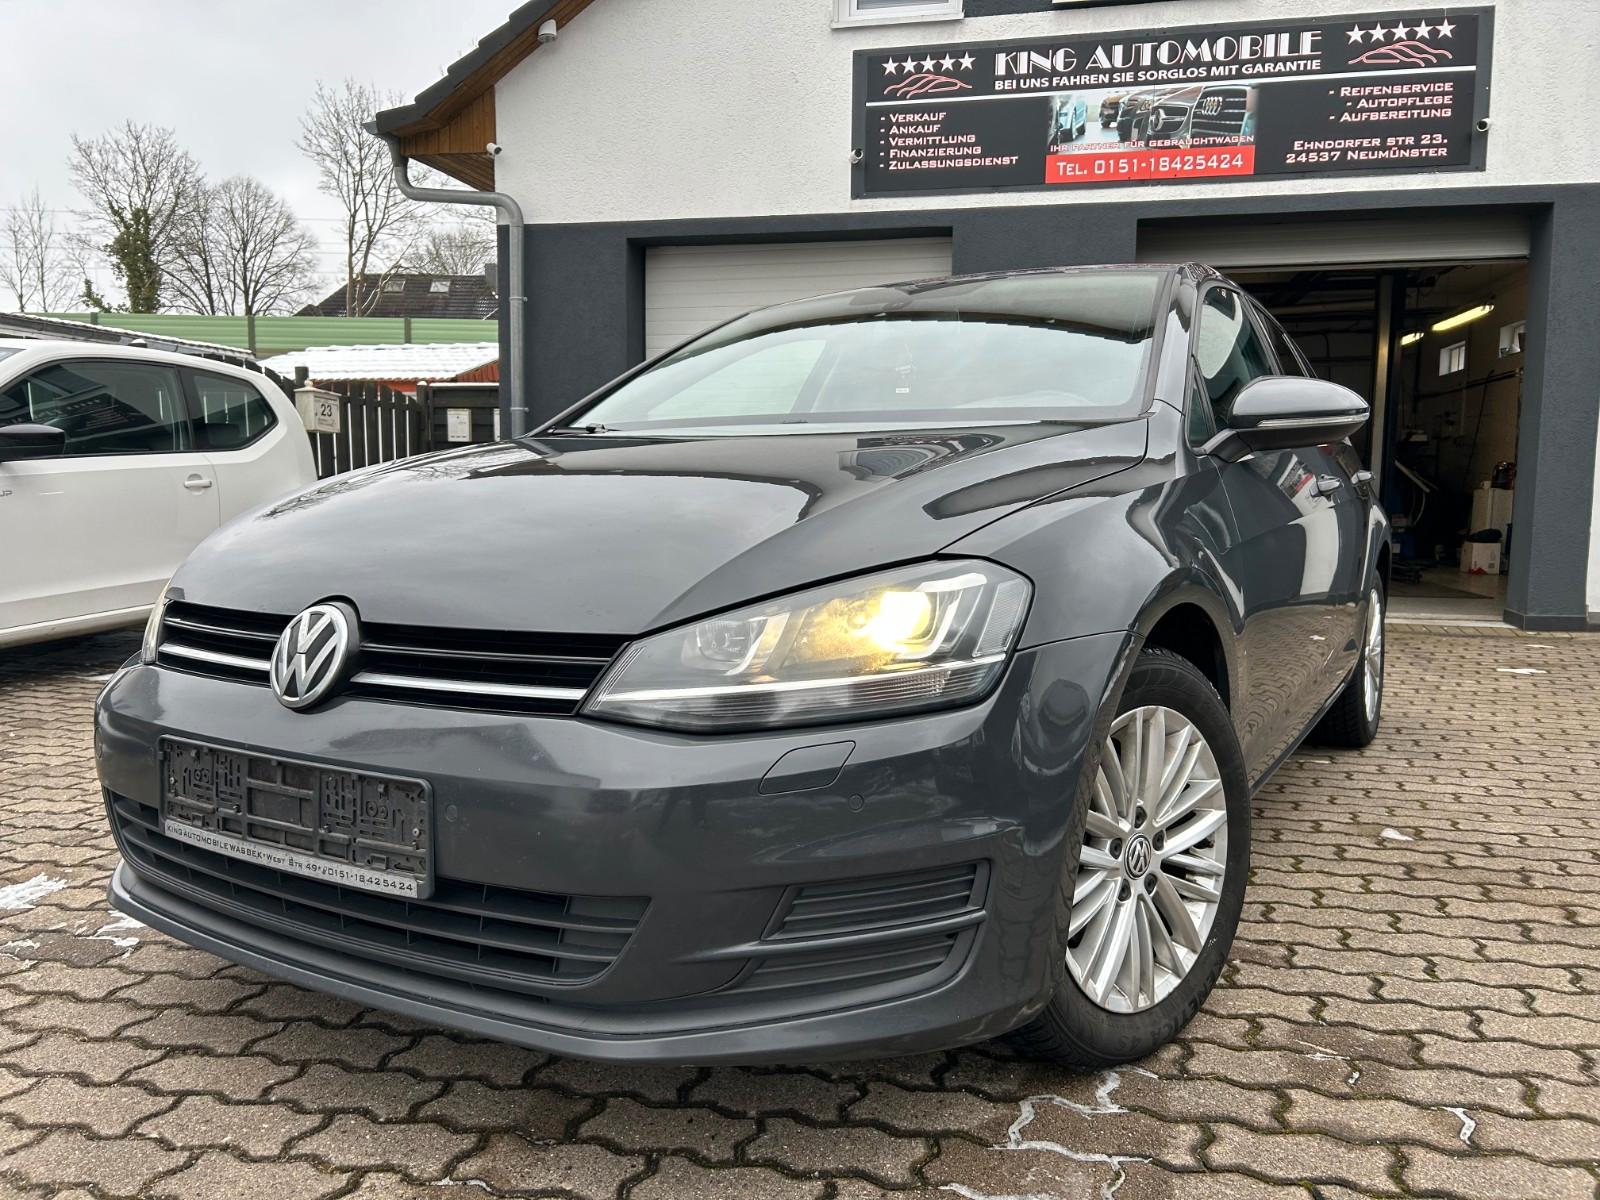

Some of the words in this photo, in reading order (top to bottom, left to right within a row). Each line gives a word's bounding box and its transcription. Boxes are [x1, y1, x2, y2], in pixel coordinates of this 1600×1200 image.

[994, 47, 1077, 76] KING
[1085, 30, 1323, 70] AUTOMOBILE
[994, 79, 1017, 91] BEI
[1020, 77, 1049, 88] UNS
[1052, 73, 1109, 87] FAHREN
[1112, 71, 1134, 83] SIE
[1137, 67, 1207, 81] SORGLOS
[1210, 65, 1239, 77] MIT
[1241, 59, 1321, 74] GARANTIE
[1340, 82, 1454, 97] REIFENSERVICE
[1356, 95, 1453, 109] AUTOPFLEGE
[889, 112, 947, 123] VERKAUF
[1339, 108, 1452, 123] AUFBEREITUNG
[889, 124, 941, 135] ANKAUF
[888, 134, 976, 146] VERMITTLUNG
[1050, 144, 1068, 152] IHR
[1072, 142, 1120, 151] PARTNER
[1124, 139, 1145, 148] FÜR
[1149, 135, 1255, 147] GEBRAUCHTWAGEN
[1293, 137, 1381, 151] EHNDORFER
[1386, 136, 1415, 146] STR
[1420, 133, 1448, 145] 23.
[889, 146, 982, 158] FINANZIERUNG
[1285, 150, 1341, 164] 24537
[1347, 147, 1448, 161] NEUMÜNSTER
[888, 156, 1019, 170] ZULASSUNGSDIENST
[1056, 161, 1088, 176] TEL.
[1094, 153, 1244, 175] 0151-18425424
[320, 403, 333, 417] 23
[167, 824, 183, 836] KING
[183, 830, 229, 850] AUTOMOBILE
